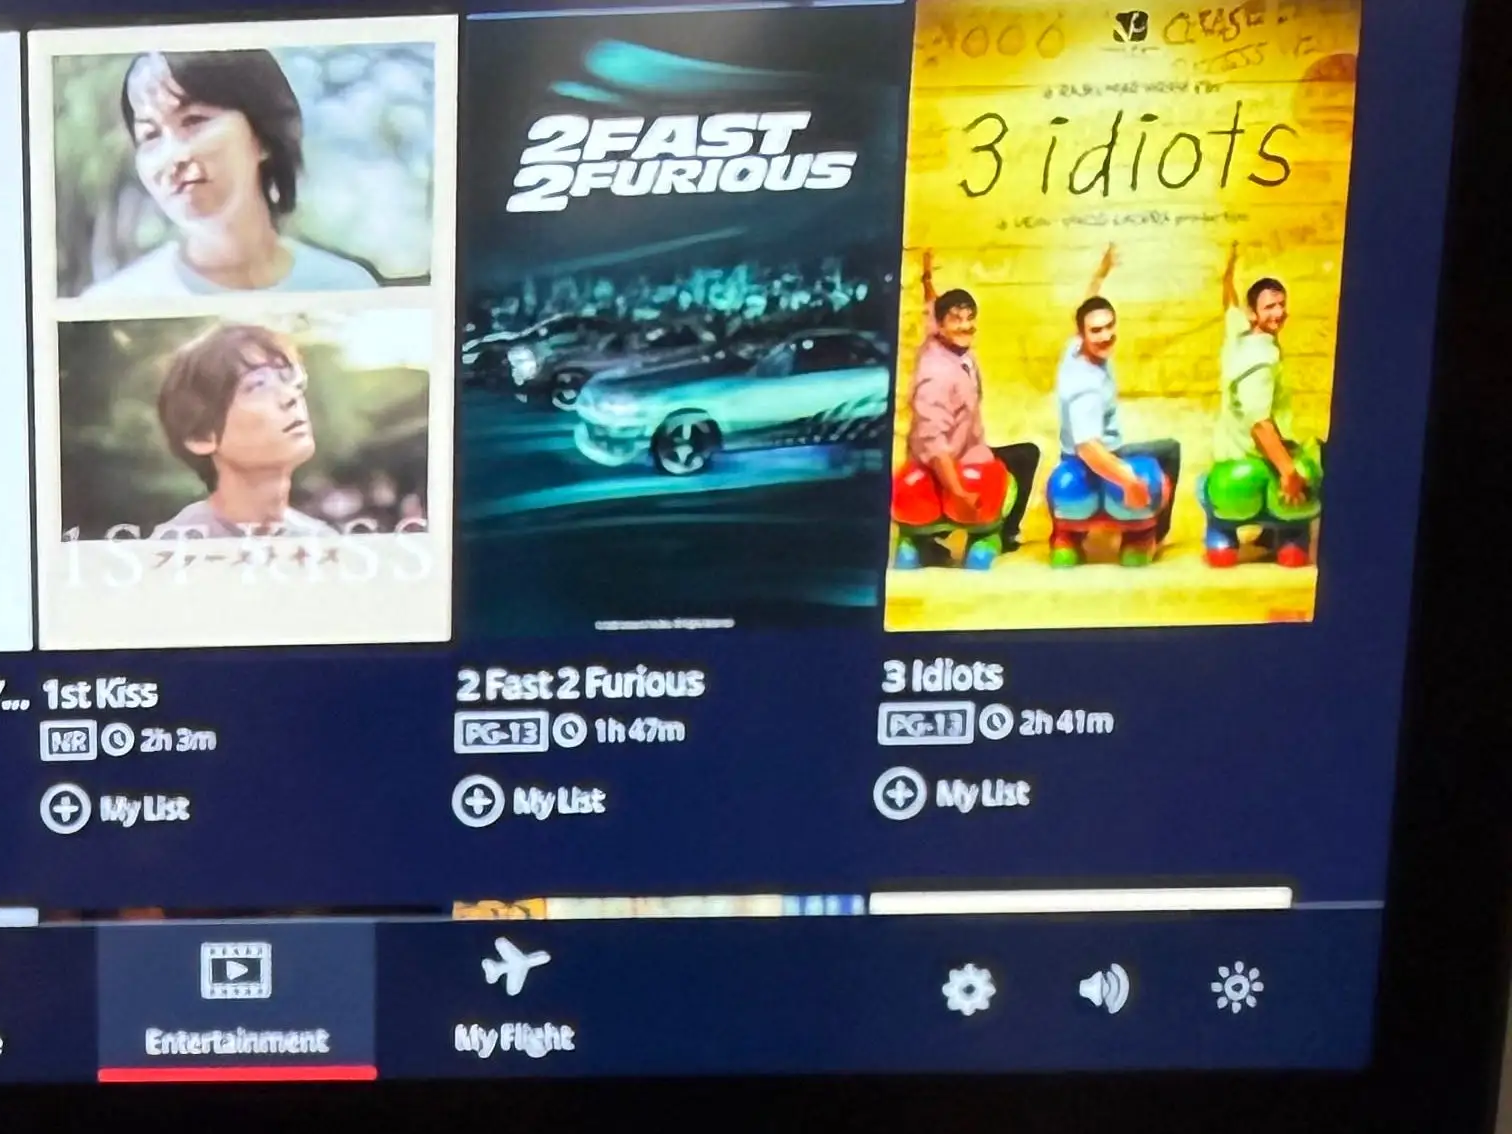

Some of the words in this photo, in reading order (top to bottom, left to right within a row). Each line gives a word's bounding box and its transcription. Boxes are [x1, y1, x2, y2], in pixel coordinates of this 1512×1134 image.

[958, 113, 1008, 197] 3
[1042, 101, 1297, 194] idiots
[456, 669, 481, 701] 2
[485, 667, 554, 701] Fast
[556, 666, 580, 699] 2
[585, 664, 706, 699] Furious
[881, 660, 906, 692] 3
[911, 658, 1004, 692] Idiots
[42, 679, 91, 709] 1st
[95, 677, 159, 709] Kiss
[464, 721, 538, 745] PG-13
[595, 717, 625, 742] 1h
[628, 717, 685, 742] 47m
[1019, 709, 1052, 736] 2h
[1056, 709, 1114, 735] 41m
[51, 730, 87, 753] NR
[141, 728, 172, 752] 2h
[176, 728, 216, 752] 3m
[100, 796, 141, 827] My
[144, 795, 190, 821] List
[513, 786, 555, 820] My
[557, 786, 607, 814] List
[936, 778, 979, 813] My
[981, 777, 1031, 807] List
[144, 1026, 330, 1056] Entertainment
[454, 1024, 497, 1059] My
[500, 1022, 575, 1058] Flight
